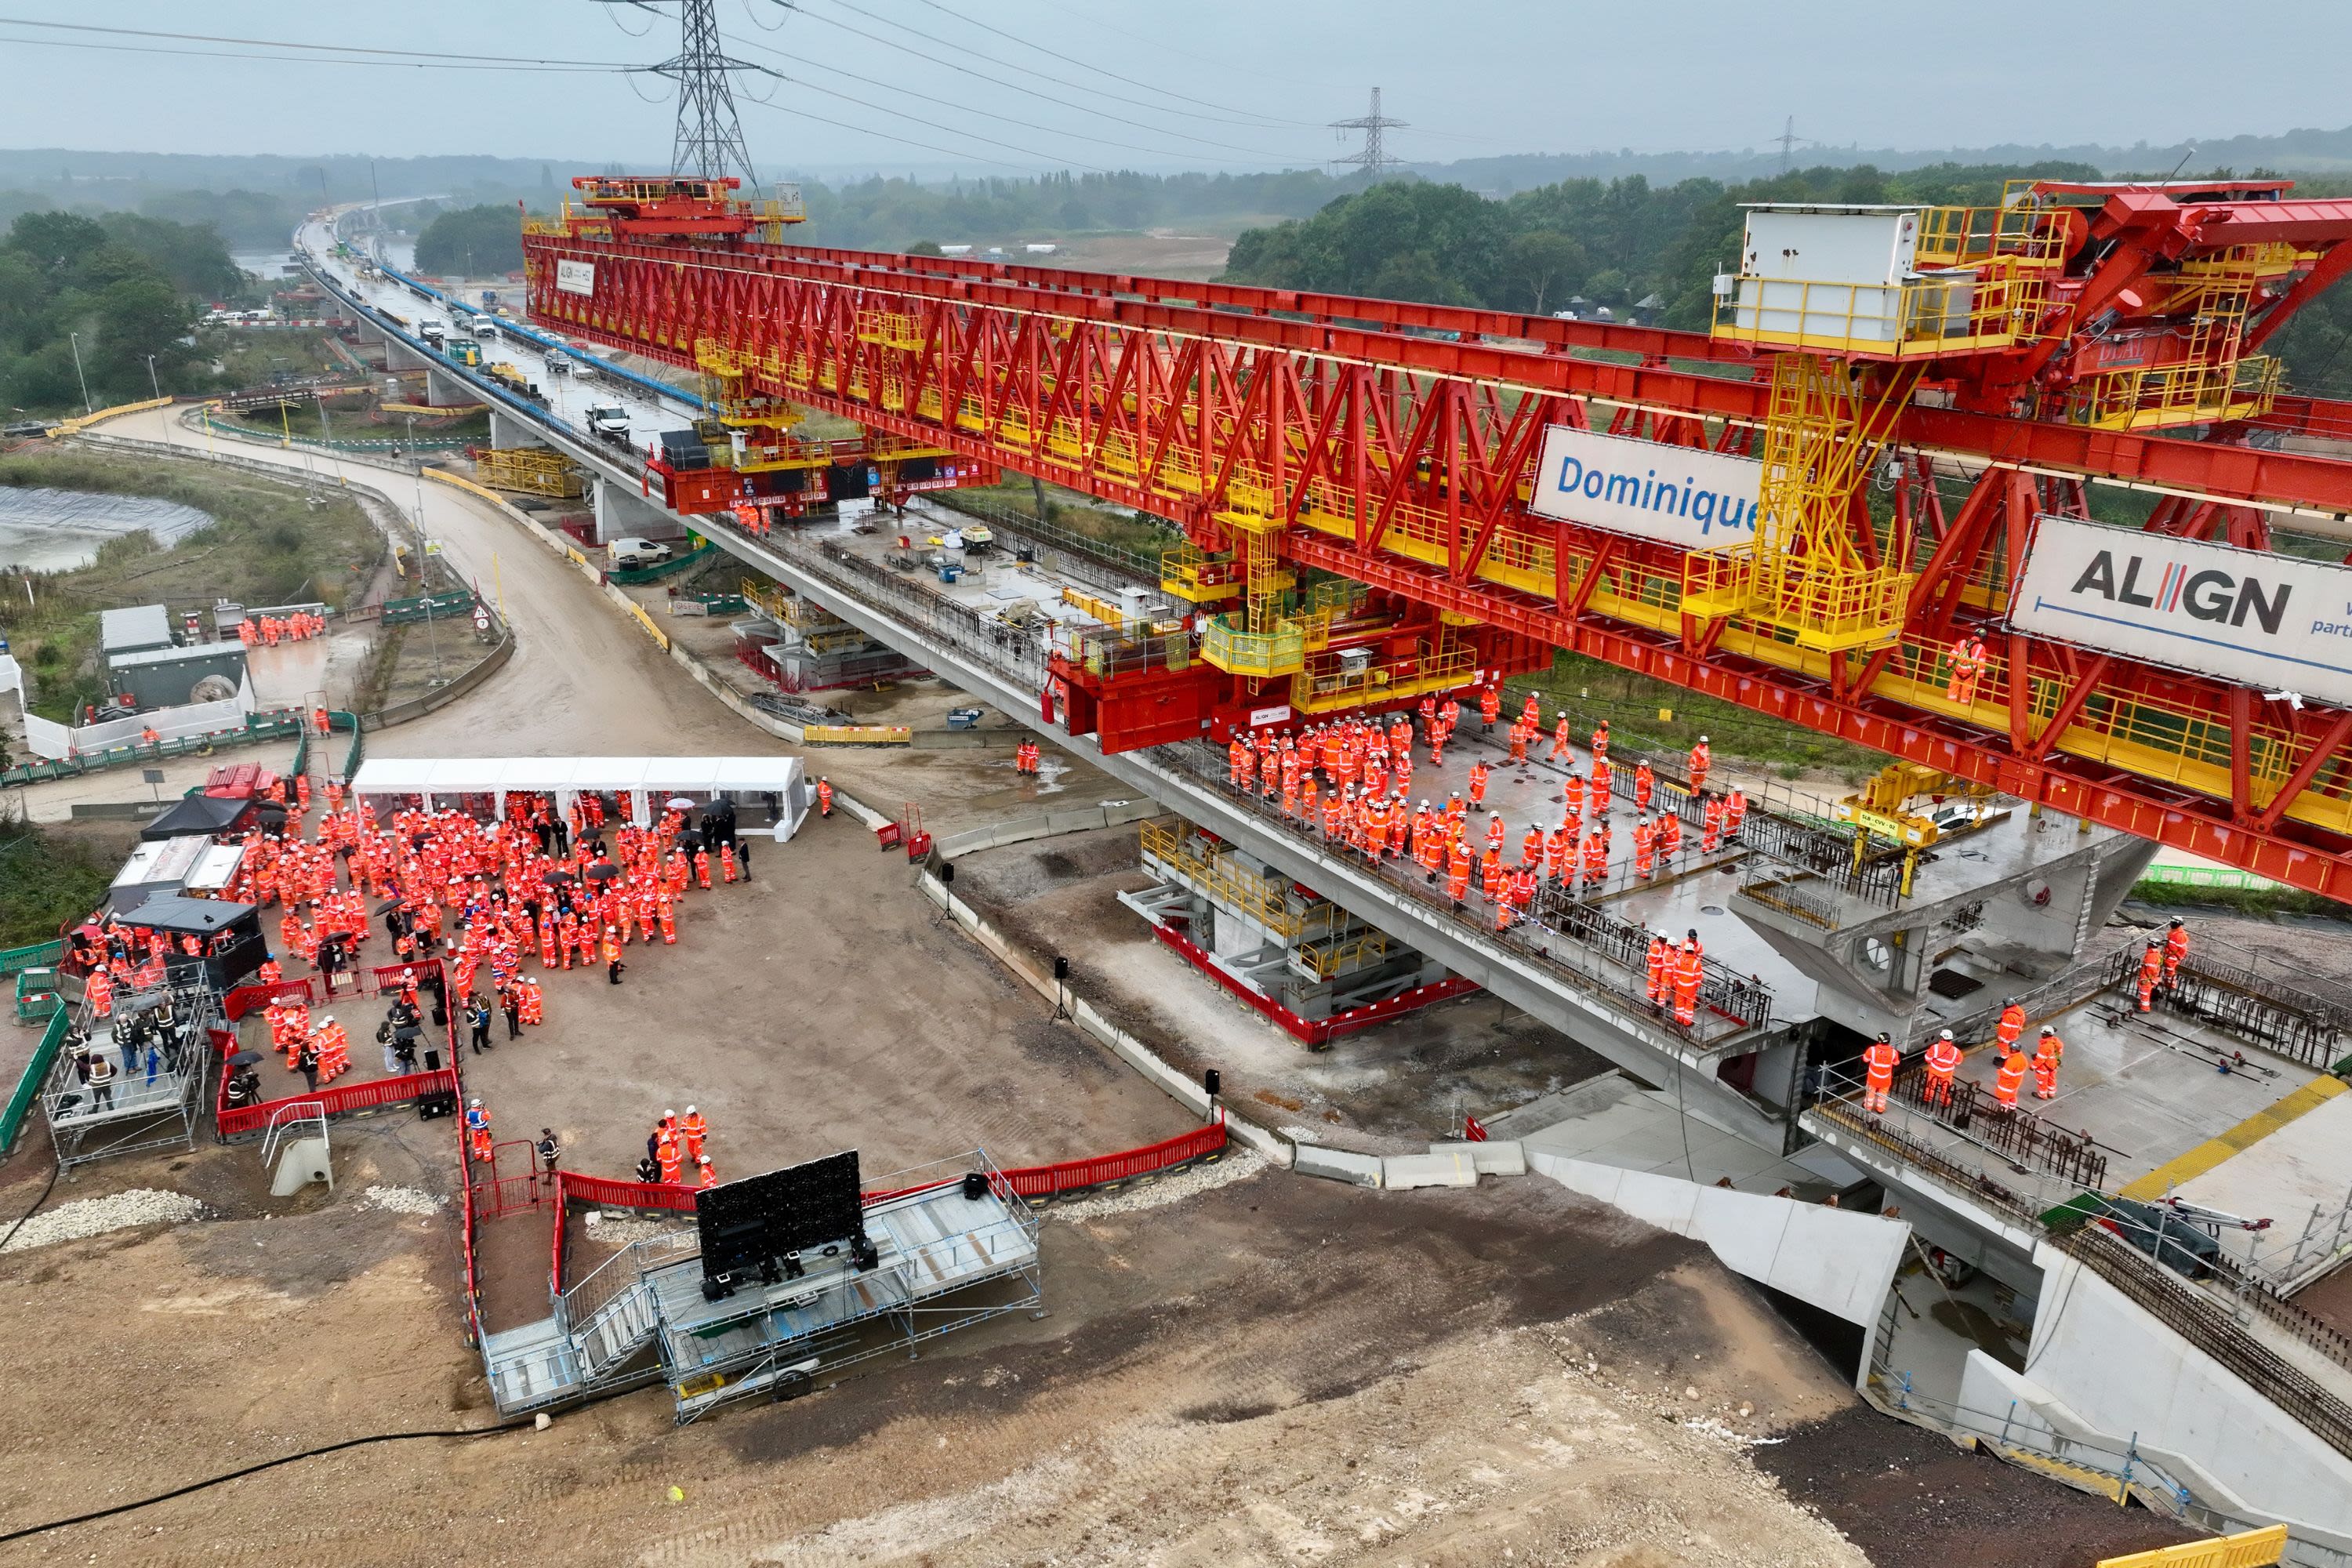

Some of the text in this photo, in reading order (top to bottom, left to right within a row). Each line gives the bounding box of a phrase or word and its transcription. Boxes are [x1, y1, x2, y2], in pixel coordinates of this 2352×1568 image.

[1558, 456, 1771, 535] Dominique
[2071, 550, 2292, 634] ALIGN
[2026, 768, 2034, 776] 121
